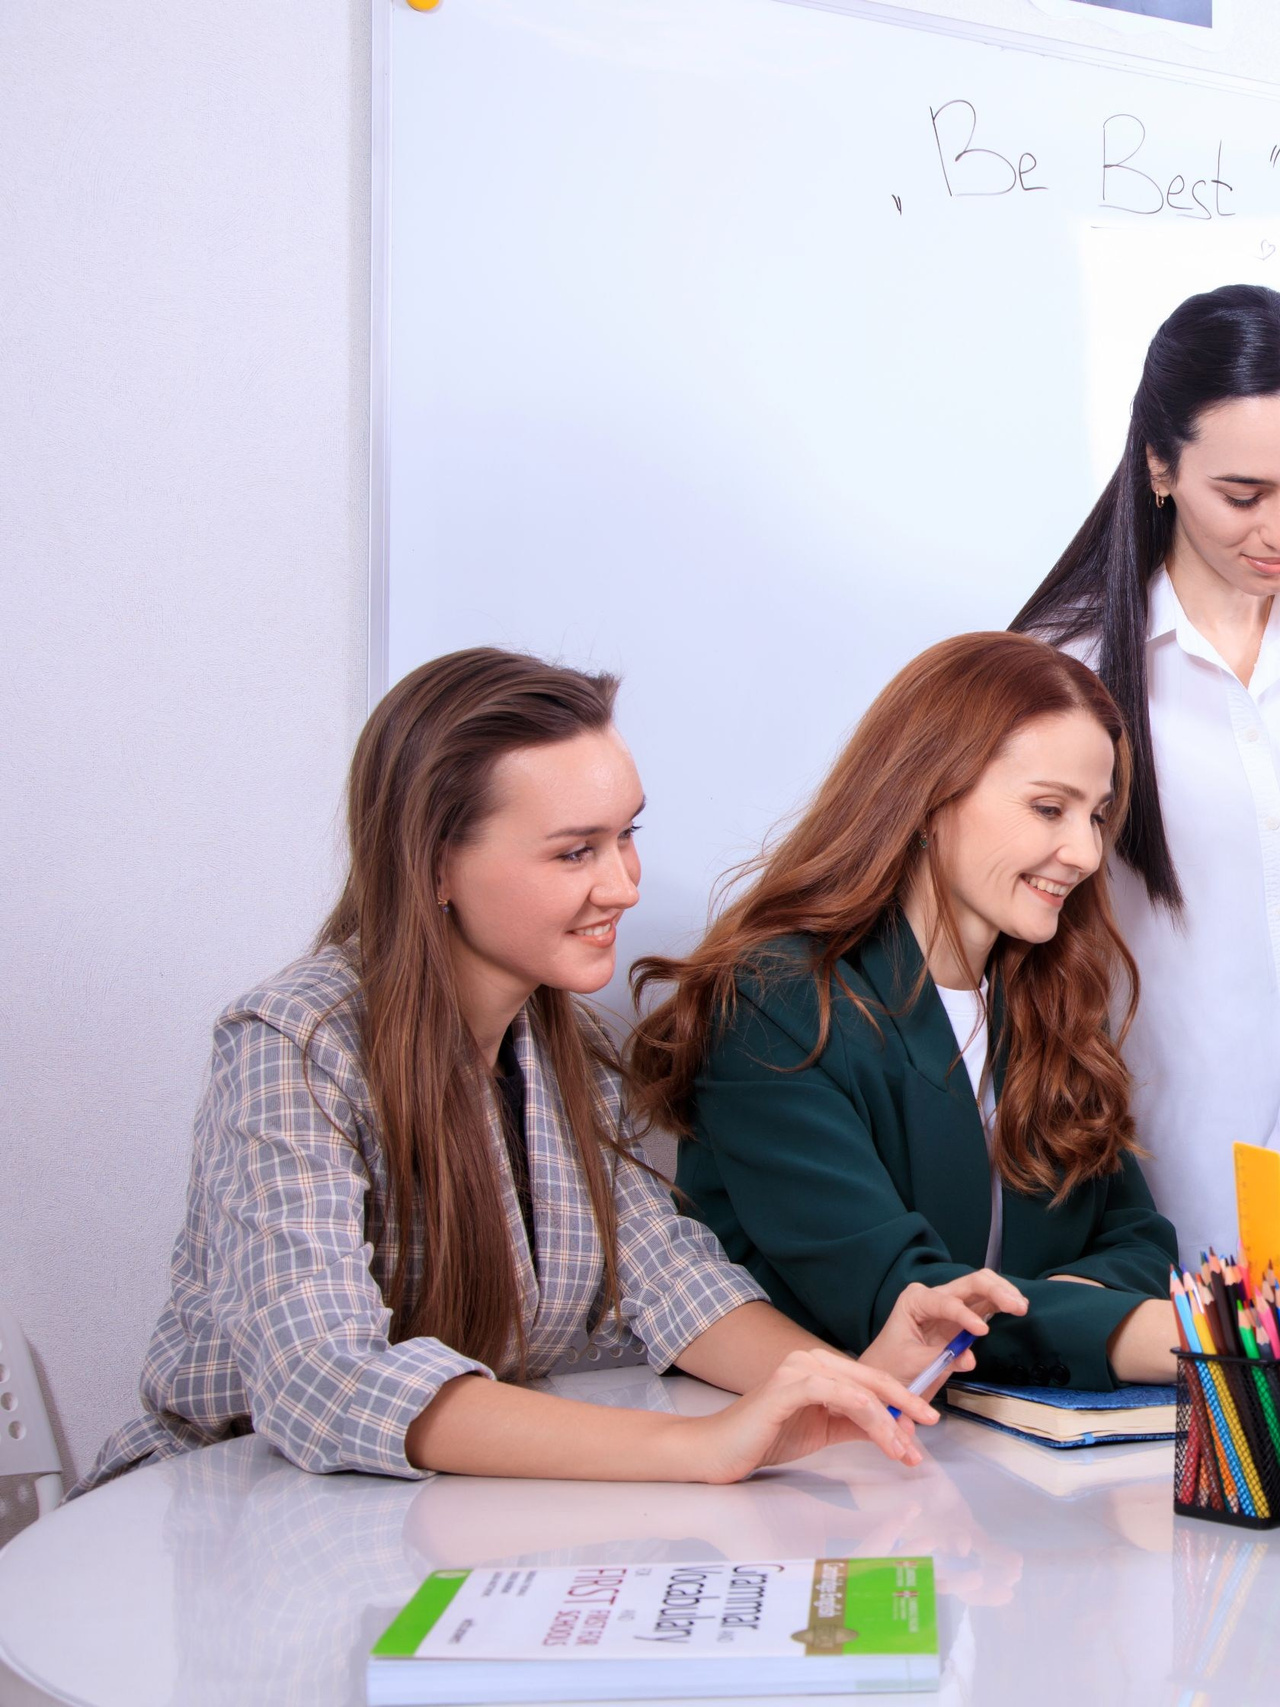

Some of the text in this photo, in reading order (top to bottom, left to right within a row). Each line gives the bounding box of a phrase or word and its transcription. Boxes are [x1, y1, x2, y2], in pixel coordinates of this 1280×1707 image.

[563, 1568, 628, 1606] FIRST
[633, 1564, 726, 1644] Vocabulary
[720, 1563, 785, 1630] Grammar
[541, 1610, 582, 1647] SCHOOLS
